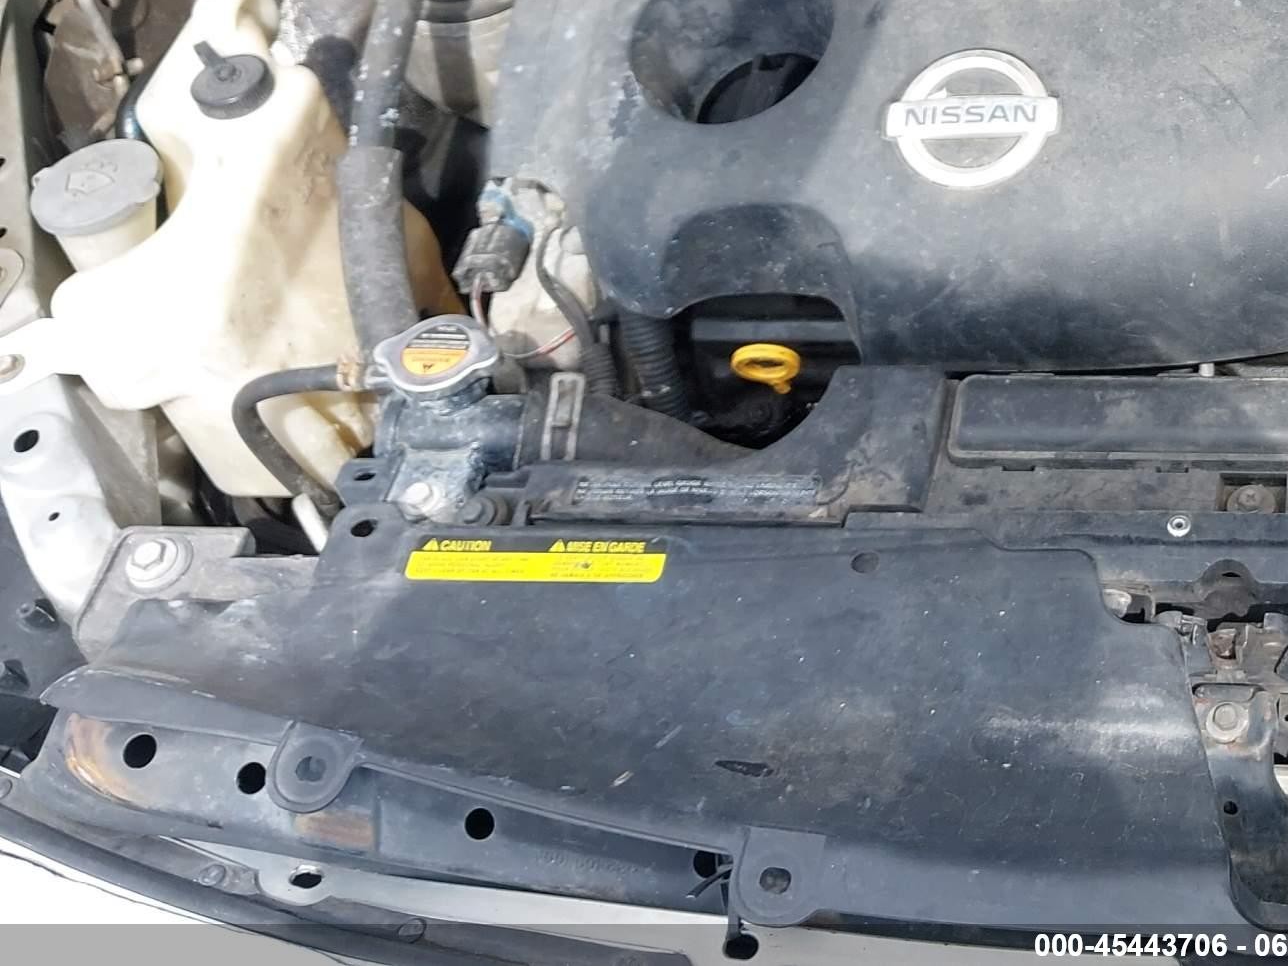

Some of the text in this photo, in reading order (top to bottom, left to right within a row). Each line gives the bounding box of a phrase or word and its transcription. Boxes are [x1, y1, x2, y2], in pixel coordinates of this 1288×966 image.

[904, 104, 1037, 127] NISSAN
[439, 540, 492, 552] CAUTION
[566, 541, 647, 554] MISE EN GARDE
